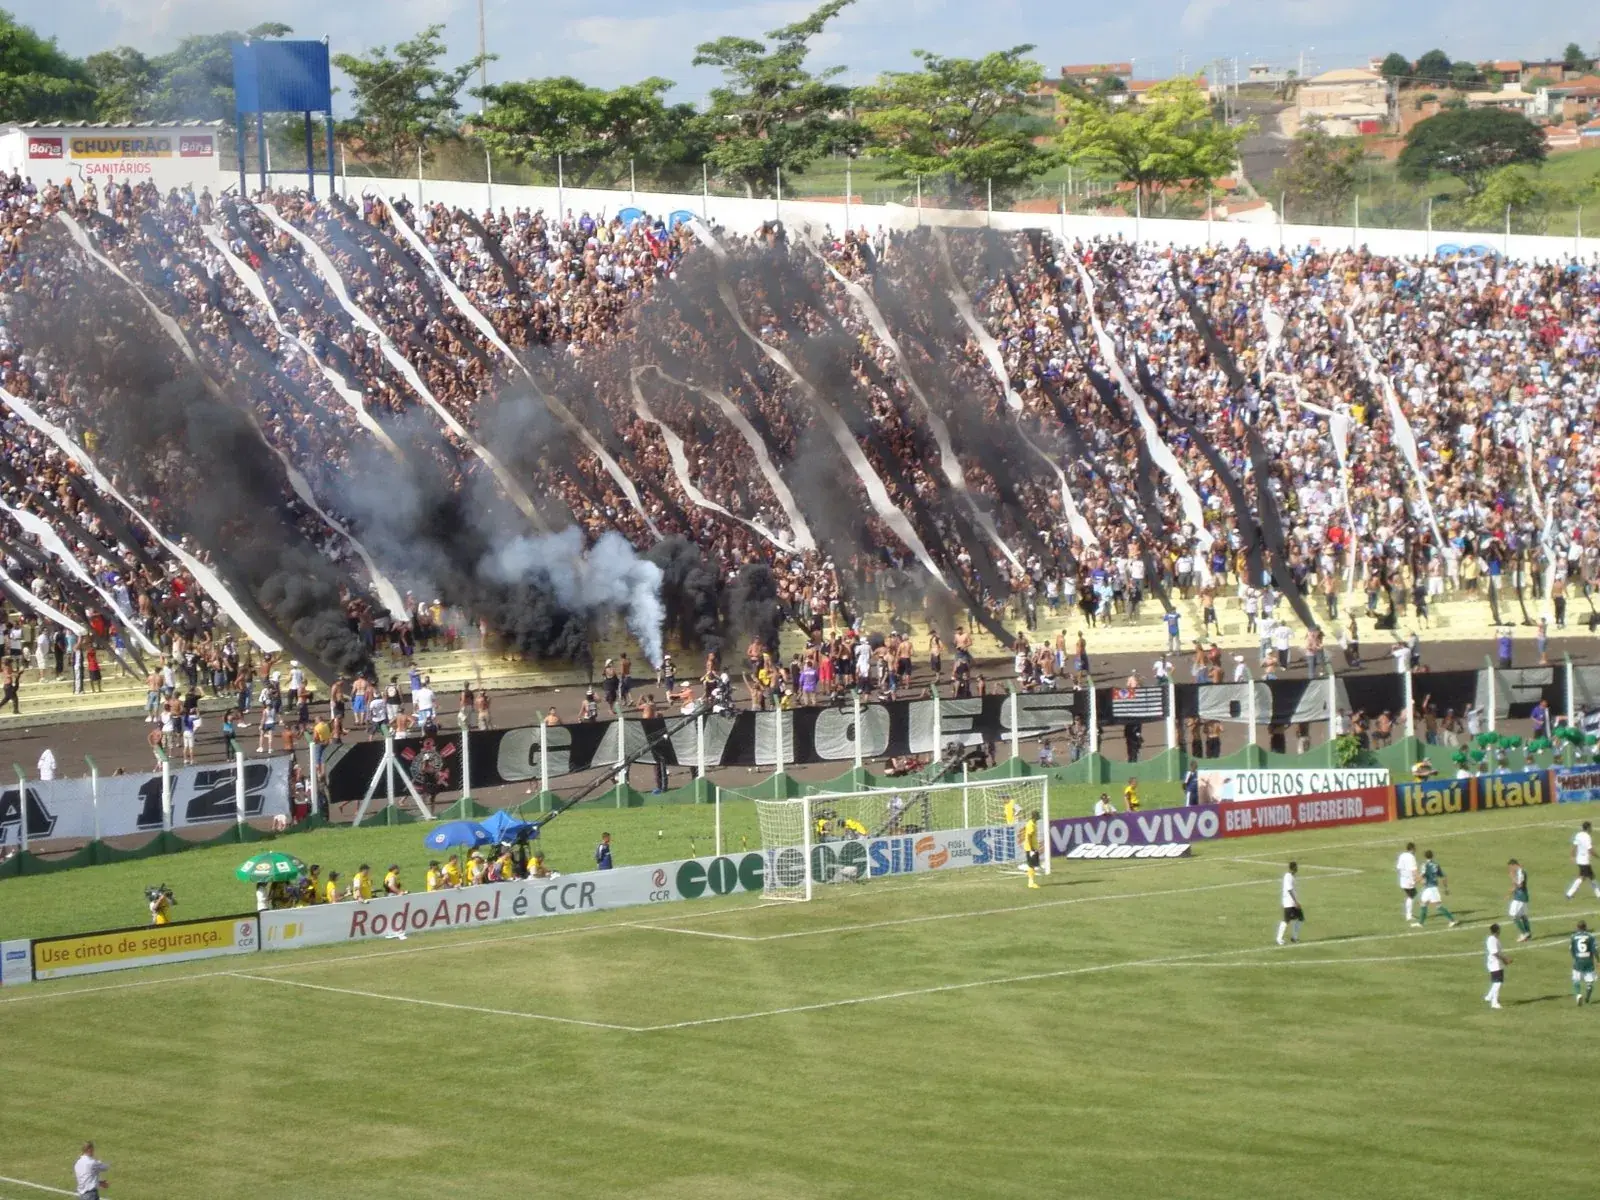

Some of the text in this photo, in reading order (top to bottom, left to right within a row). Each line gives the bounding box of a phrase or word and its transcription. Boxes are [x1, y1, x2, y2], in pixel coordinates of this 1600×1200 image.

[72, 136, 171, 154] CHUVEIRÃO
[85, 160, 152, 174] SANITÁRIOS
[136, 763, 272, 831] 12
[1236, 772, 1387, 795] TOUROS CANCHIM
[1404, 782, 1462, 817] Itaú
[1484, 773, 1543, 809] Itaú
[1050, 810, 1219, 853] VIVO VIVO
[1225, 797, 1363, 832] BEM-VINDO, GUERREIRO
[1067, 843, 1191, 858] Gatorade
[350, 881, 596, 938] RodoAnel é CCR
[650, 890, 670, 902] CCR
[42, 948, 70, 964] Use
[75, 942, 113, 960] cinto
[118, 938, 137, 954] de
[142, 931, 222, 952] segurança.
